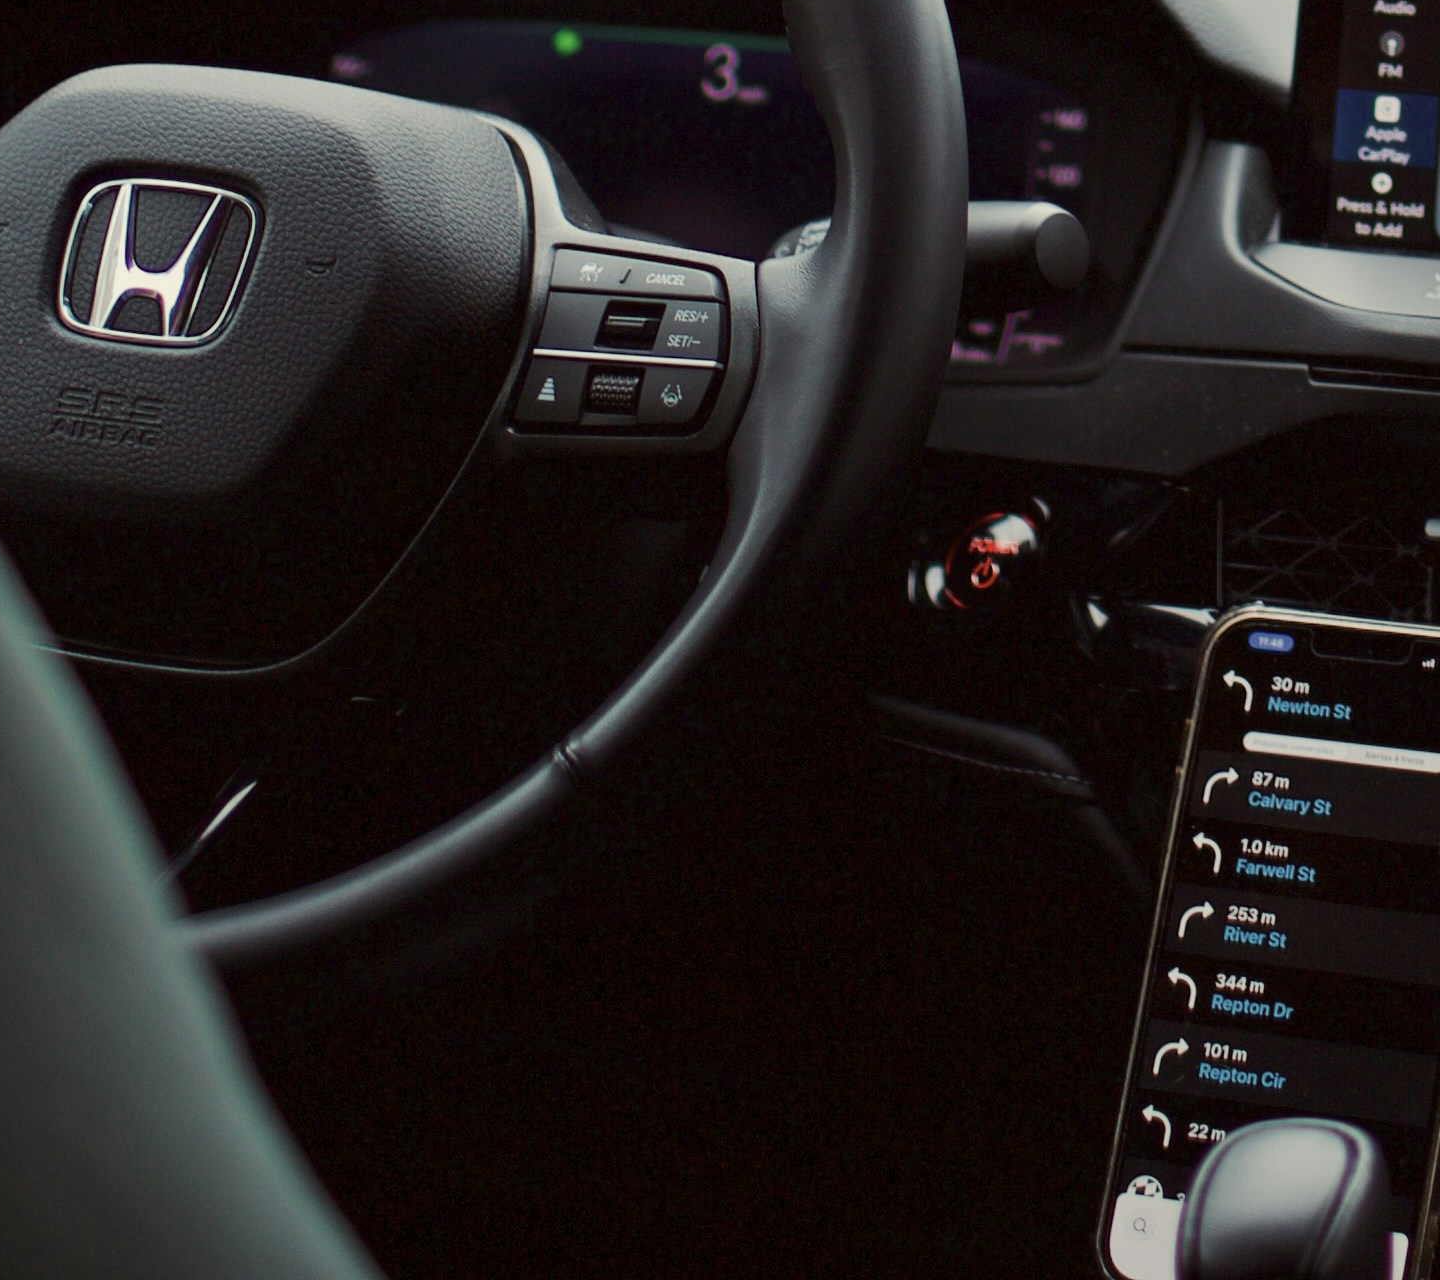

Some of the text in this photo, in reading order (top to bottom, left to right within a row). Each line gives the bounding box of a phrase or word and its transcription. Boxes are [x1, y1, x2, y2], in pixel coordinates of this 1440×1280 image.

[700, 42, 740, 102] 3
[1377, 62, 1404, 79] FM
[1364, 124, 1408, 143] Apple
[1357, 146, 1411, 167] CarPlay
[1336, 196, 1426, 219] Press & Hold
[1355, 220, 1404, 239] to Add
[645, 272, 687, 287] CANCEL
[673, 308, 710, 324] RES/+
[57, 385, 164, 424] SRS
[49, 418, 162, 450] AIRBAG
[1271, 675, 1311, 696] 30 m
[1266, 695, 1352, 721] Newton St
[1251, 770, 1291, 790] 87 m
[1247, 790, 1333, 816] Calvary St
[1240, 838, 1290, 858] 1.0 km
[1235, 857, 1317, 883] Farwell St
[1226, 904, 1277, 926] 253 m
[1223, 924, 1288, 950] River St
[1215, 972, 1266, 995] 344 m
[1210, 992, 1295, 1021] Repton Dr
[1203, 1042, 1248, 1064] 101 m
[1198, 1062, 1288, 1090] Repton Cir
[1187, 1122, 1227, 1142] 22 m
